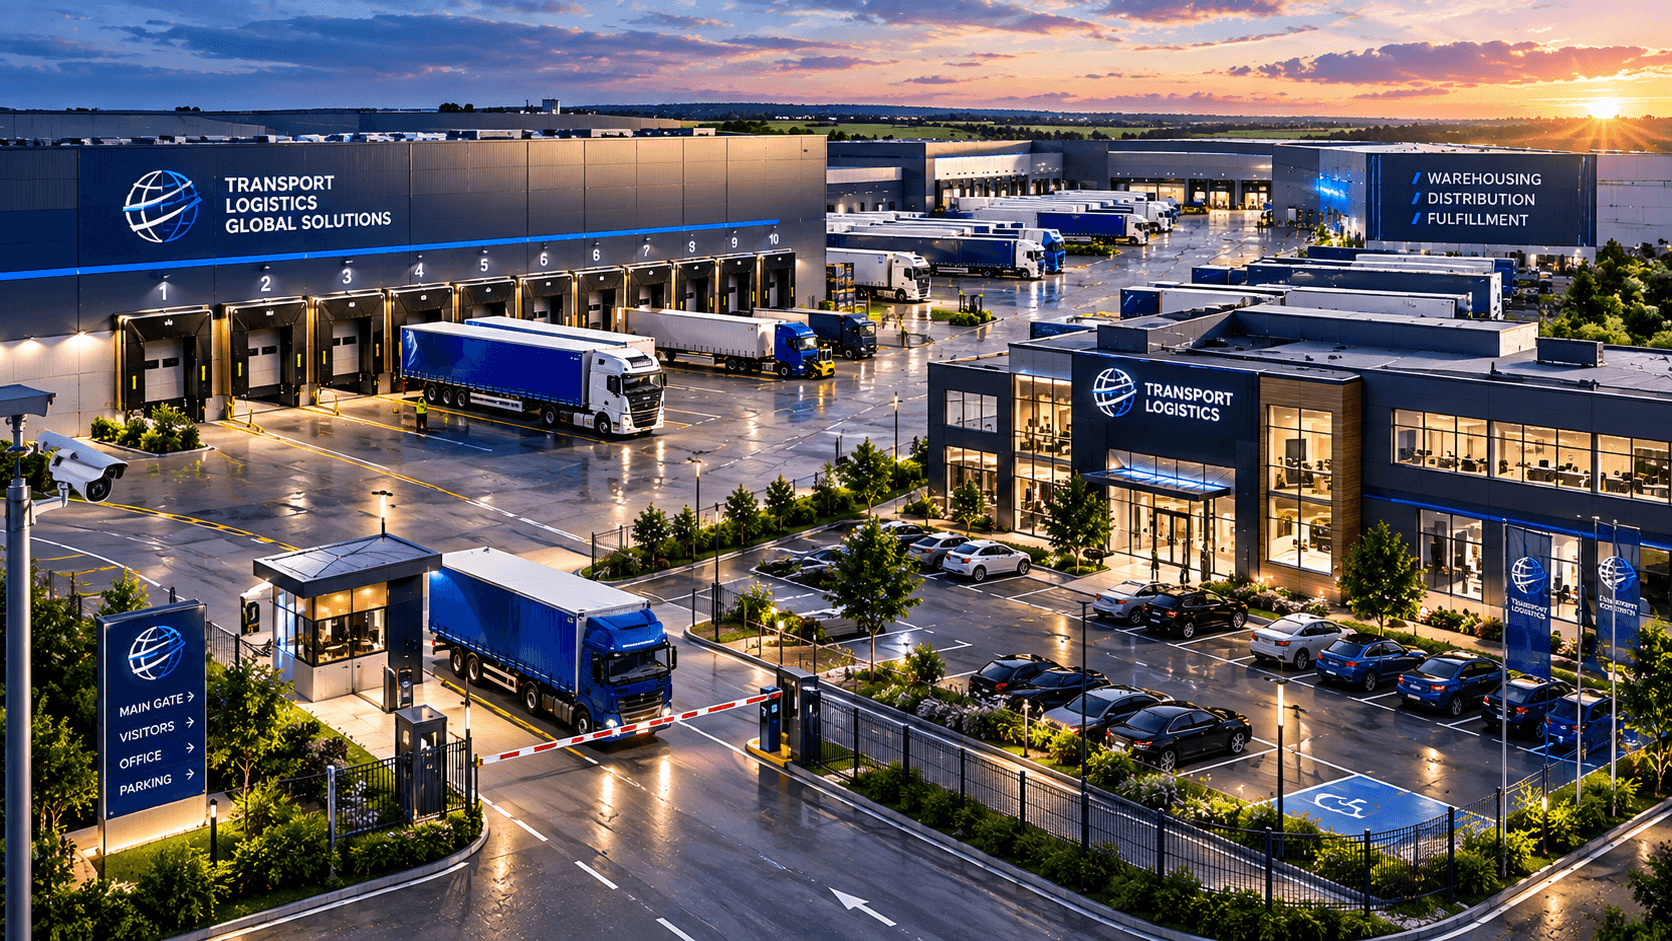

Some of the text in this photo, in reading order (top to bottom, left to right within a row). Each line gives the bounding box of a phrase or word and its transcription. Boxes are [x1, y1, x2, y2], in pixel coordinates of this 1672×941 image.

[225, 175, 335, 193] TRANSPORT
[1427, 171, 1542, 186] WAREHOUSING
[225, 195, 318, 214] LOGISTICS
[1427, 192, 1536, 206] DISTRIBUTION
[225, 211, 392, 233] GLOBAL SOLUTIONS
[1427, 212, 1529, 227] FULFILLMENT
[731, 236, 738, 249] 9
[768, 233, 779, 245] 10
[592, 248, 600, 261] 6
[643, 244, 650, 257] 7
[480, 258, 489, 272] 5
[540, 252, 548, 266] 6
[342, 268, 352, 284] 3
[414, 262, 424, 277] 4
[158, 282, 167, 300] 1
[260, 275, 271, 292] 2
[1144, 382, 1234, 406] TRANSPORT
[1145, 399, 1220, 422] LOGISTICS
[119, 693, 184, 717] MAIN GATE
[119, 721, 175, 742] VISITORS
[119, 750, 162, 769] OFFICE
[119, 774, 172, 796] PARKING
